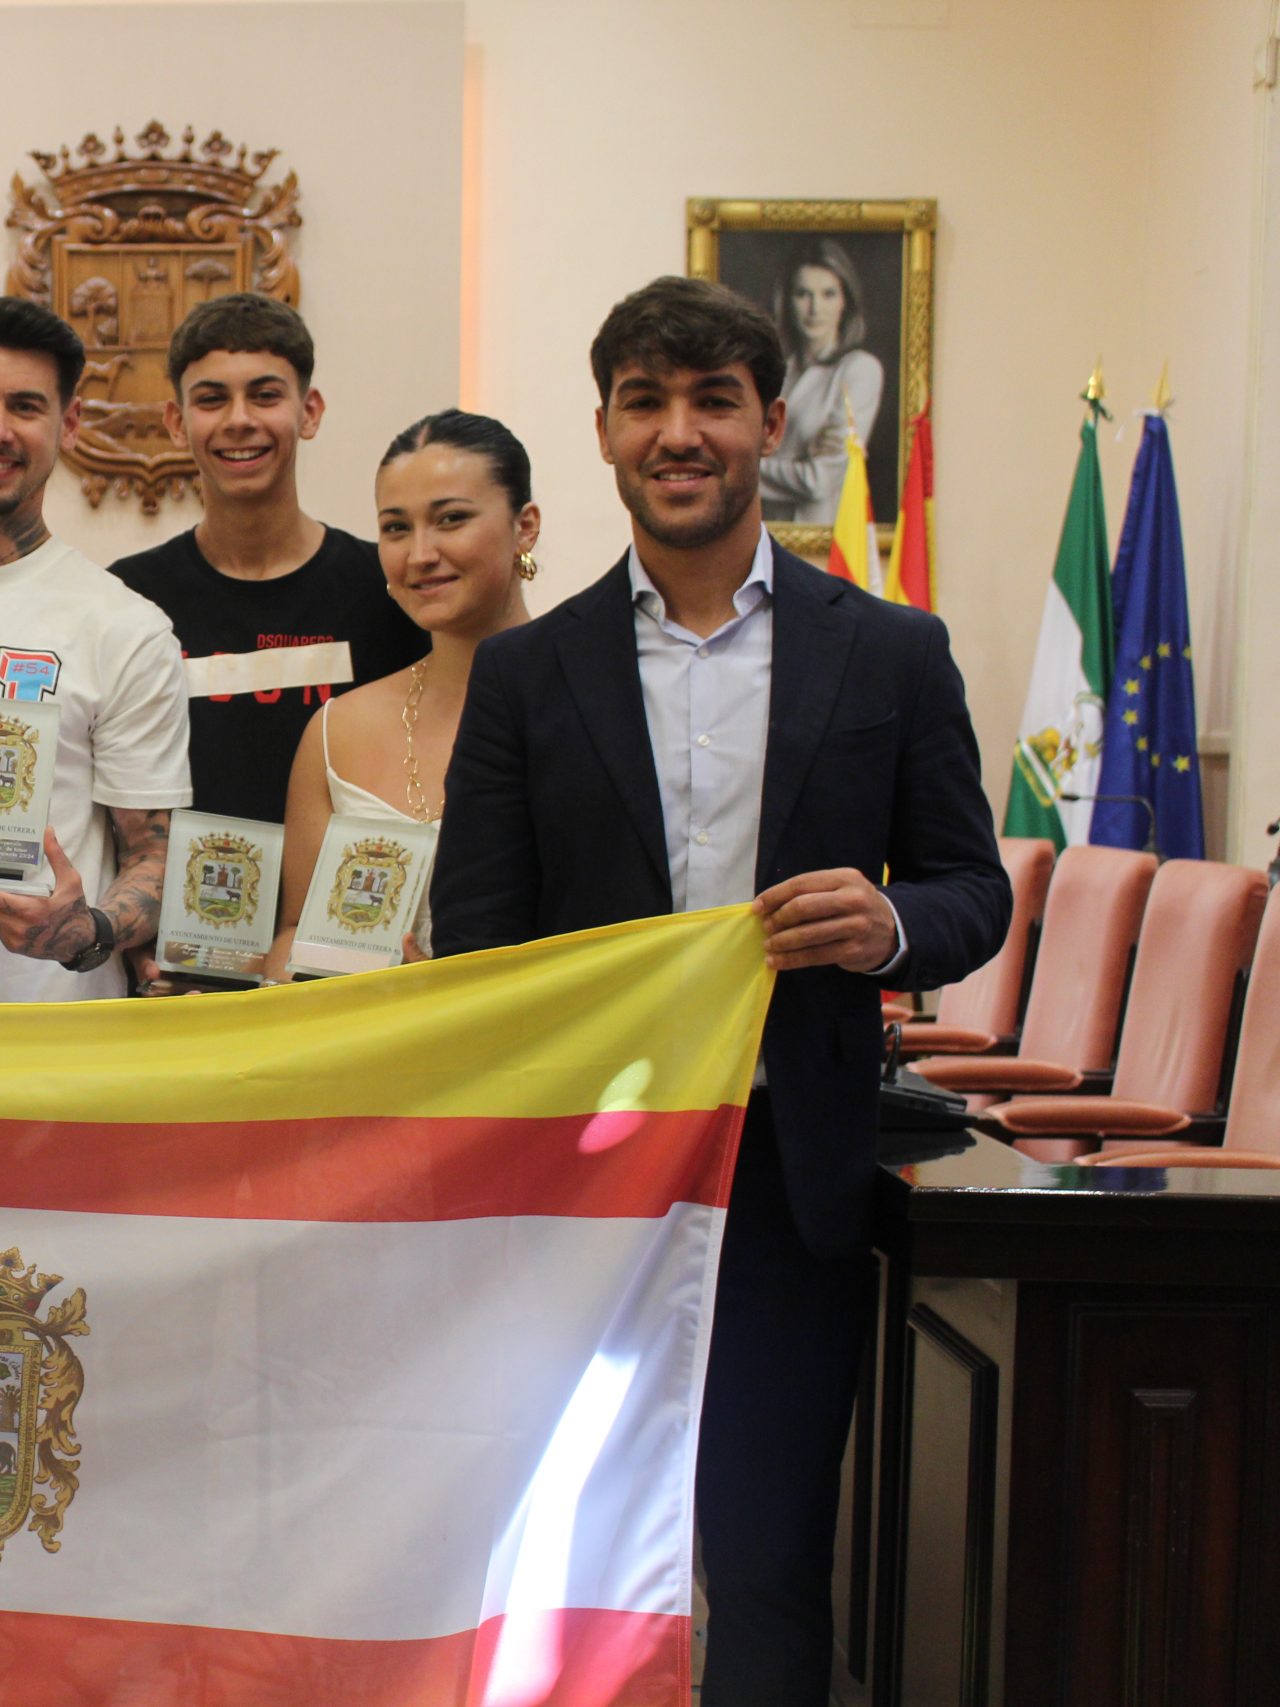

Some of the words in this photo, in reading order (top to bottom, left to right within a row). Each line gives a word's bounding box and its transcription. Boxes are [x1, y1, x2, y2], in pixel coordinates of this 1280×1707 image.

[12, 662, 49, 675] #54
[7, 825, 36, 835] UTRERA
[170, 930, 223, 942] AYUNTAMIENTO
[233, 937, 260, 947] UTRERA
[309, 935, 357, 948] AYUNTAMIENTO
[367, 943, 392, 953] UTRERA
